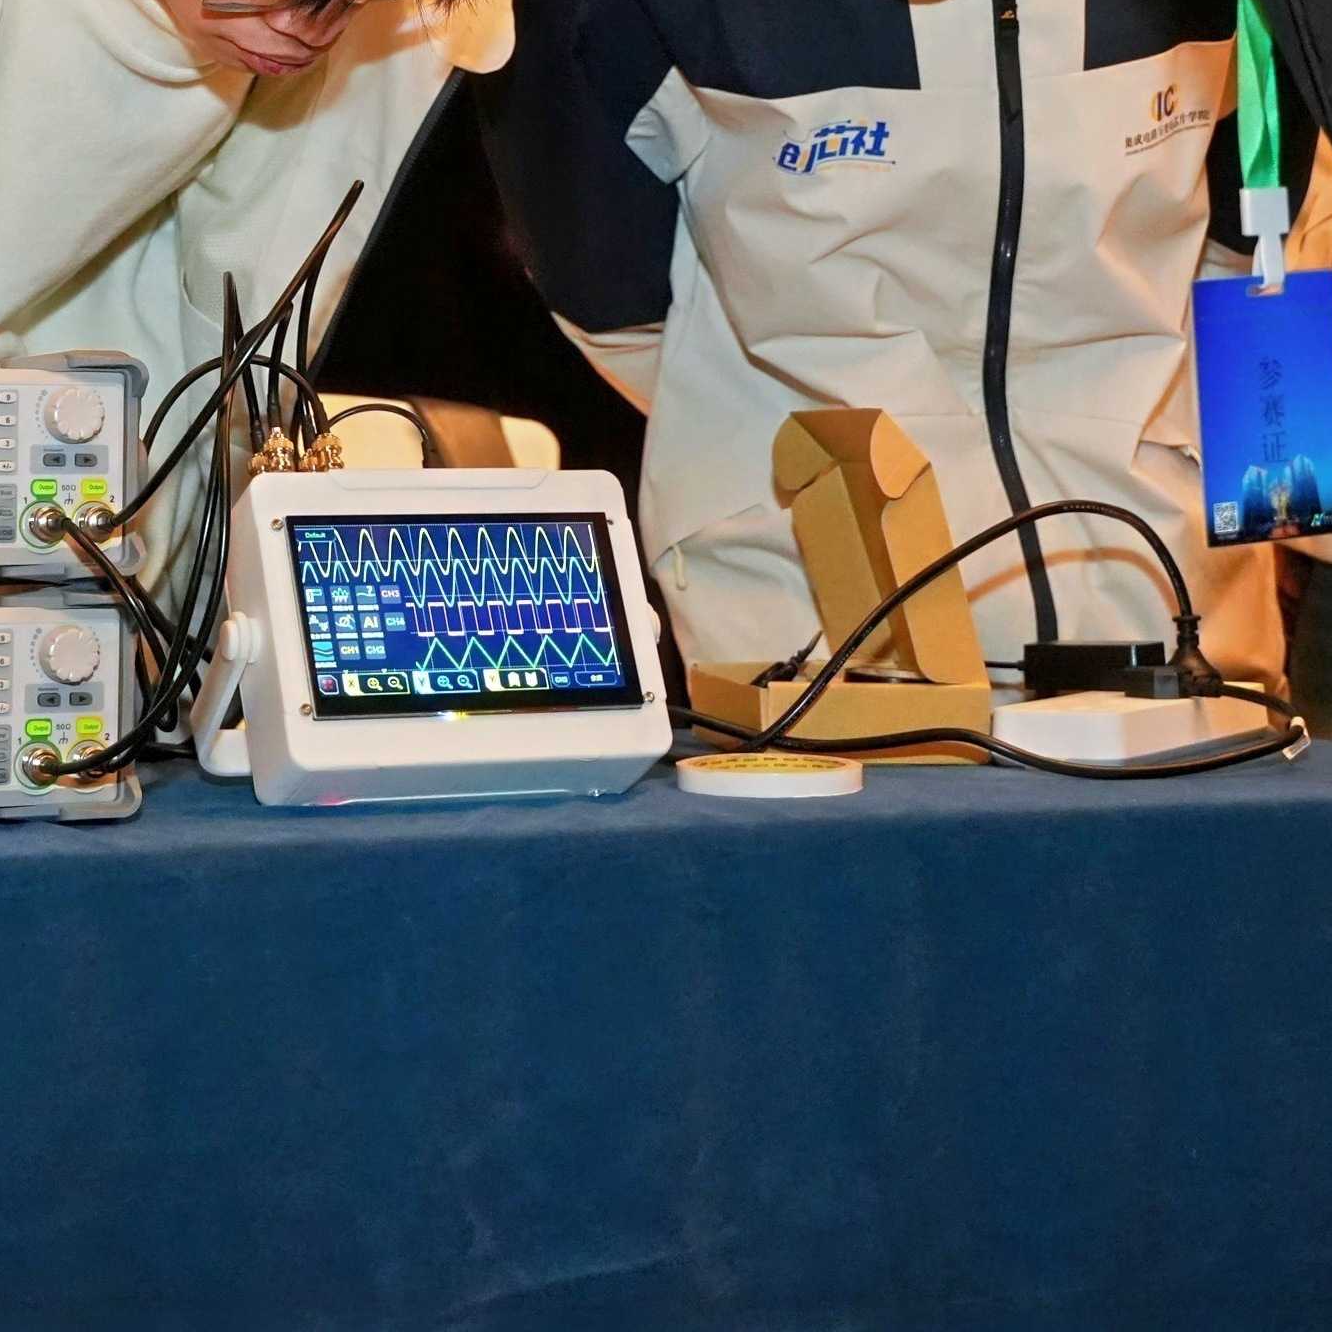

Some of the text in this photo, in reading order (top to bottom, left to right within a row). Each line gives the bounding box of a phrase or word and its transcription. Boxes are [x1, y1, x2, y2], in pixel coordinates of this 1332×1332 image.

[1259, 355, 1287, 463] 参赛证
[363, 616, 379, 629] AI
